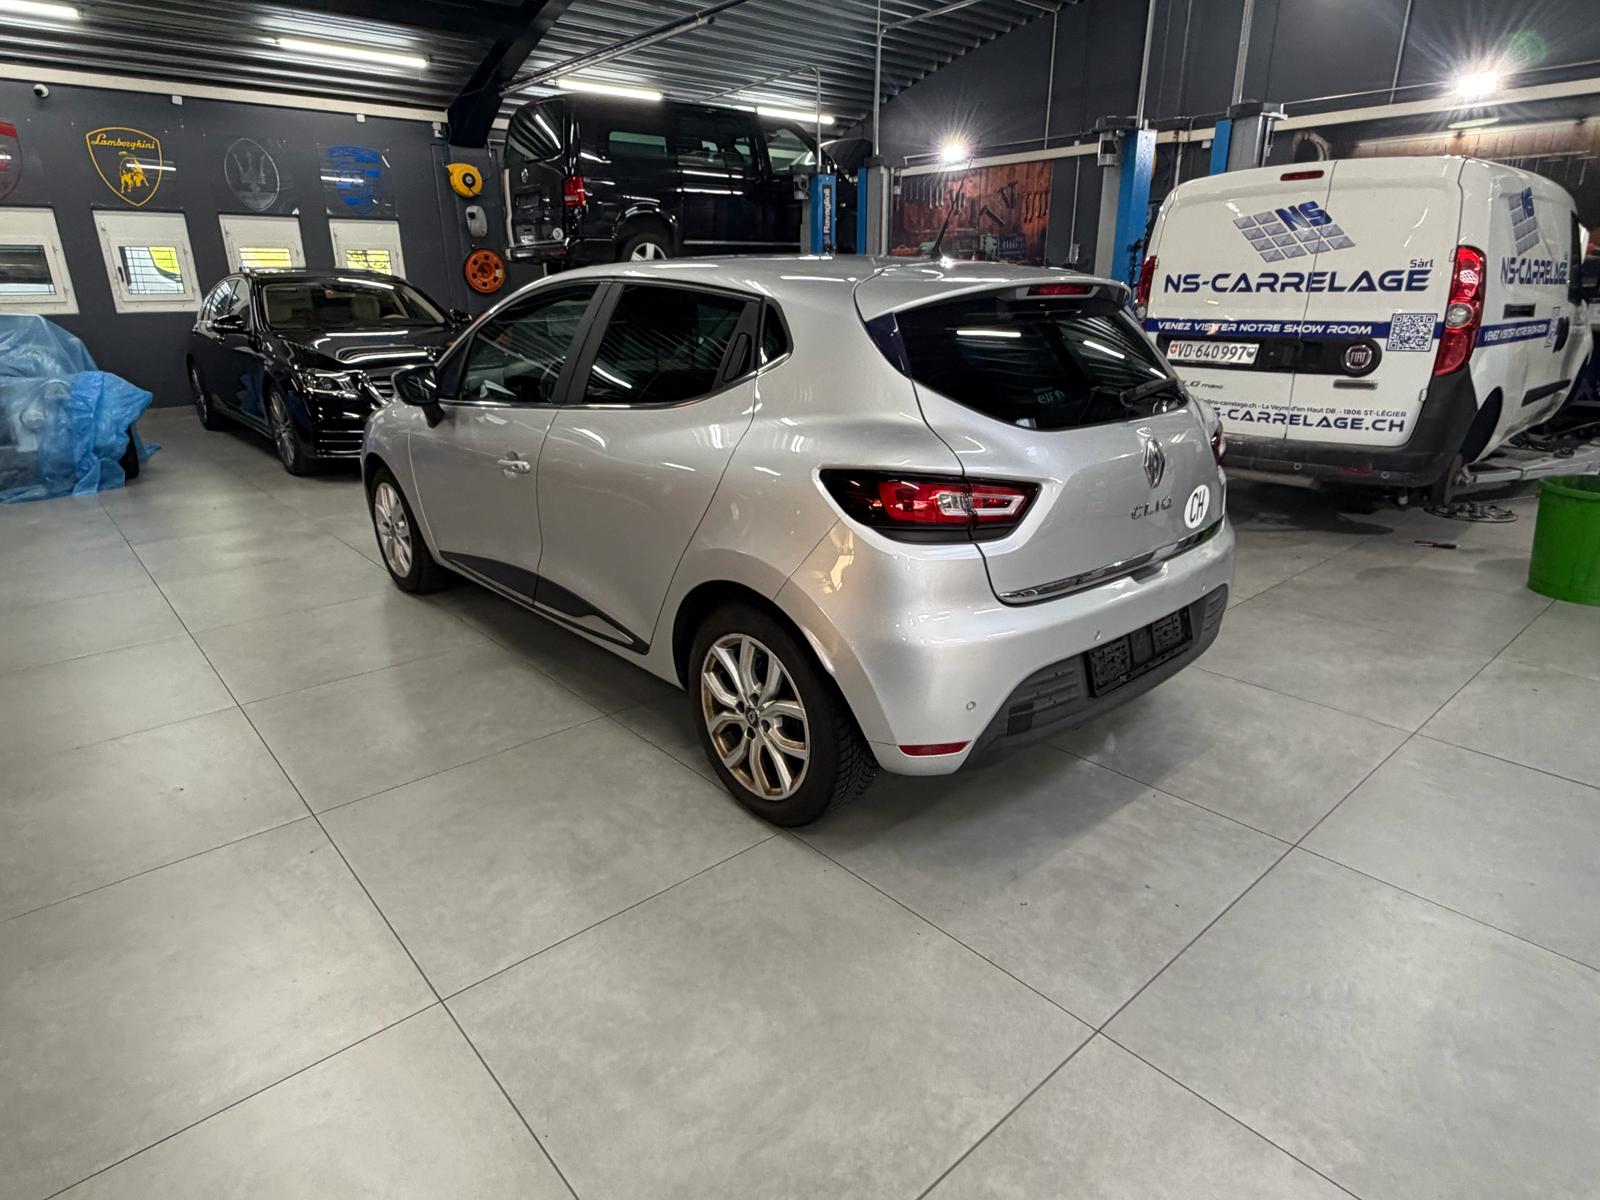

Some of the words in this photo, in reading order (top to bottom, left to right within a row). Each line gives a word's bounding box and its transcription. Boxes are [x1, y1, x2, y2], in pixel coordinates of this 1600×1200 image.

[90, 133, 155, 150] Lamborghini
[1274, 200, 1333, 232] NS
[1163, 268, 1433, 294] NS-CARRELAGE
[1158, 321, 1192, 331] VENEZ
[1194, 322, 1238, 333] VISTER
[1239, 323, 1281, 333] NOTRE
[1283, 324, 1325, 334] SHOW
[1327, 324, 1373, 335] ROOM
[1350, 350, 1367, 364] FIAT
[1213, 407, 1405, 432] S-CARRELAGE.CH
[1306, 406, 1324, 414] Haut
[1343, 408, 1362, 416] 1806
[1363, 409, 1407, 418] ST-LÉGIER
[1131, 496, 1173, 520] CLIO
[1189, 487, 1204, 523] CH
